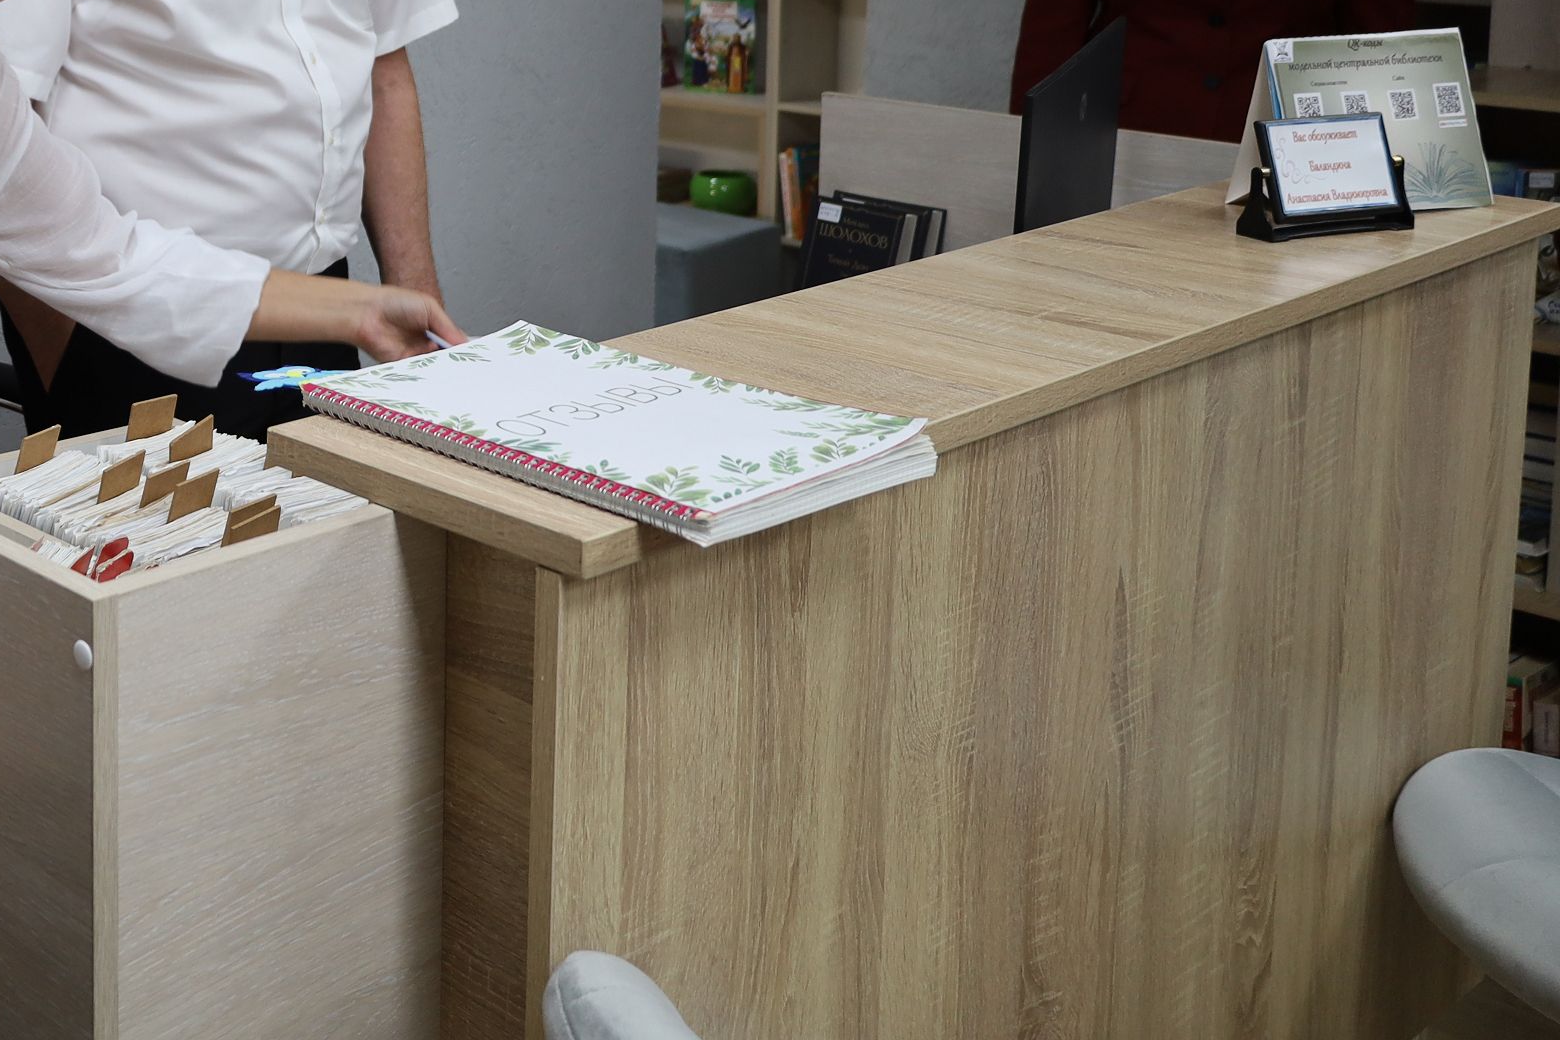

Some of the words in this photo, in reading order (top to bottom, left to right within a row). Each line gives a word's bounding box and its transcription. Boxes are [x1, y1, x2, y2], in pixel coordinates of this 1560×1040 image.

[1347, 38, 1383, 51] QR-коды
[1289, 60, 1333, 72] модельной
[1333, 56, 1390, 71] центральной
[1391, 53, 1443, 67] библиотеки
[1292, 131, 1306, 143] Вас
[1308, 128, 1358, 144] обслуживает
[1309, 160, 1352, 173] Баландина
[1287, 193, 1331, 204] Анастасия
[1331, 188, 1388, 202] Владимировна
[496, 376, 694, 437] ОТЗЫВЫ
